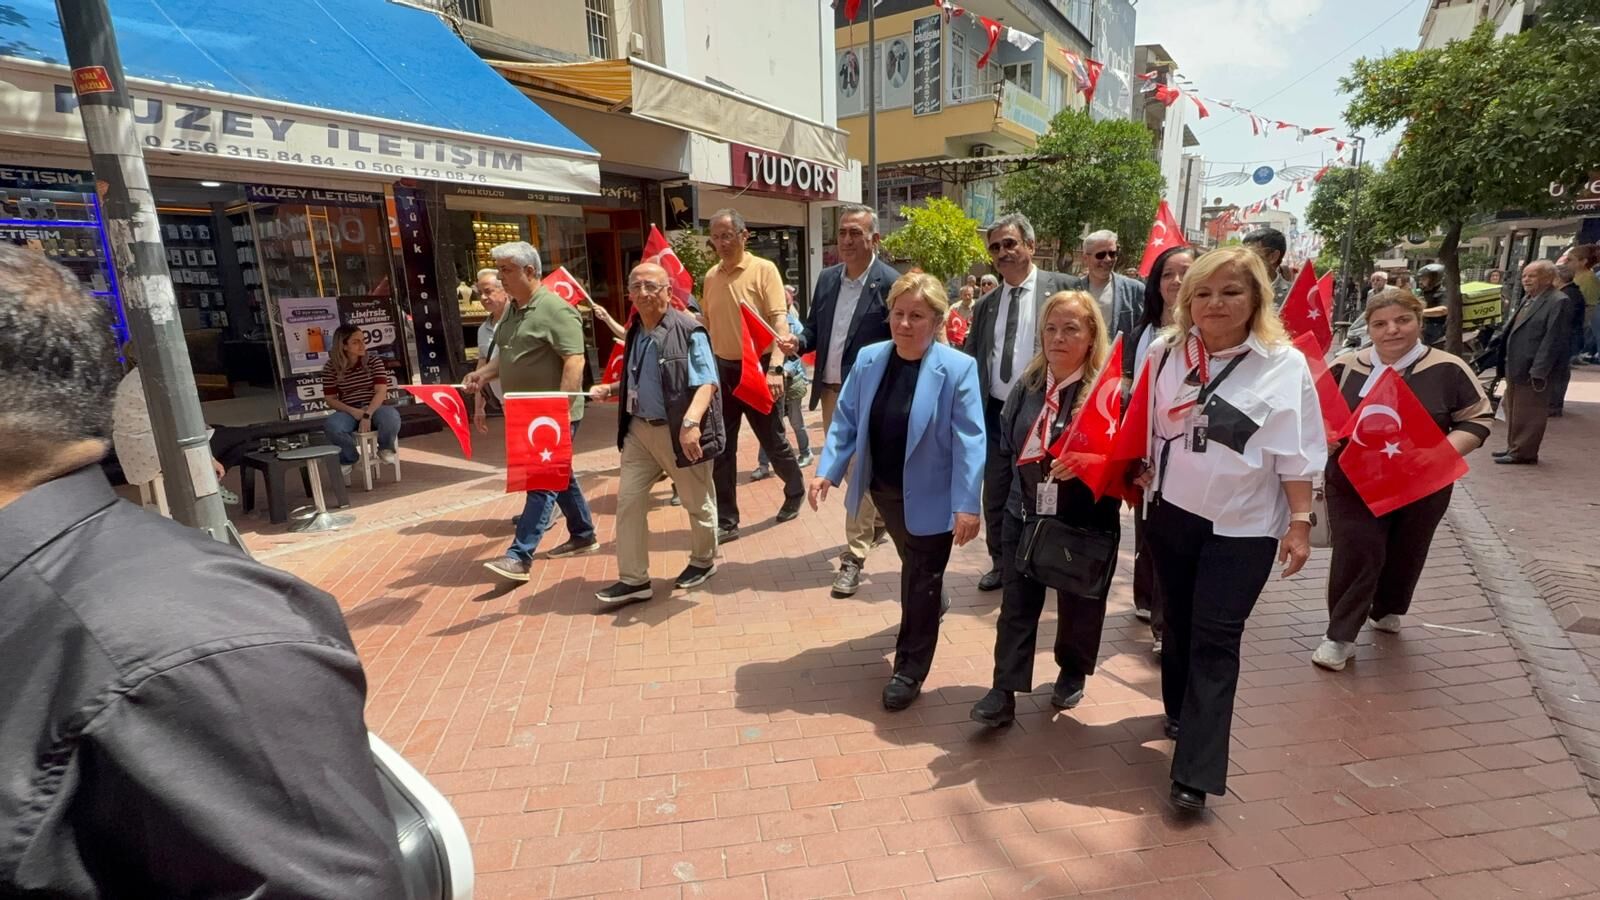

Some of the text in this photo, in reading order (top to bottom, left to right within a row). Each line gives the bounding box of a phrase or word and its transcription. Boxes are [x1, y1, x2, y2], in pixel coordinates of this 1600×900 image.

[145, 135, 161, 148] 0
[170, 138, 219, 154] 256
[310, 154, 336, 168] 84
[354, 160, 366, 170] 0
[372, 162, 405, 176] 506
[411, 166, 440, 179] 179
[445, 170, 465, 182] 08
[469, 172, 488, 184] 76
[327, 123, 523, 172] İLETİŞİM
[251, 185, 307, 200] KUZEY
[747, 151, 837, 195] TUDORS
[406, 196, 440, 373] Türk Telekom
[1473, 305, 1496, 316] vigo
[302, 386, 316, 398] 3
